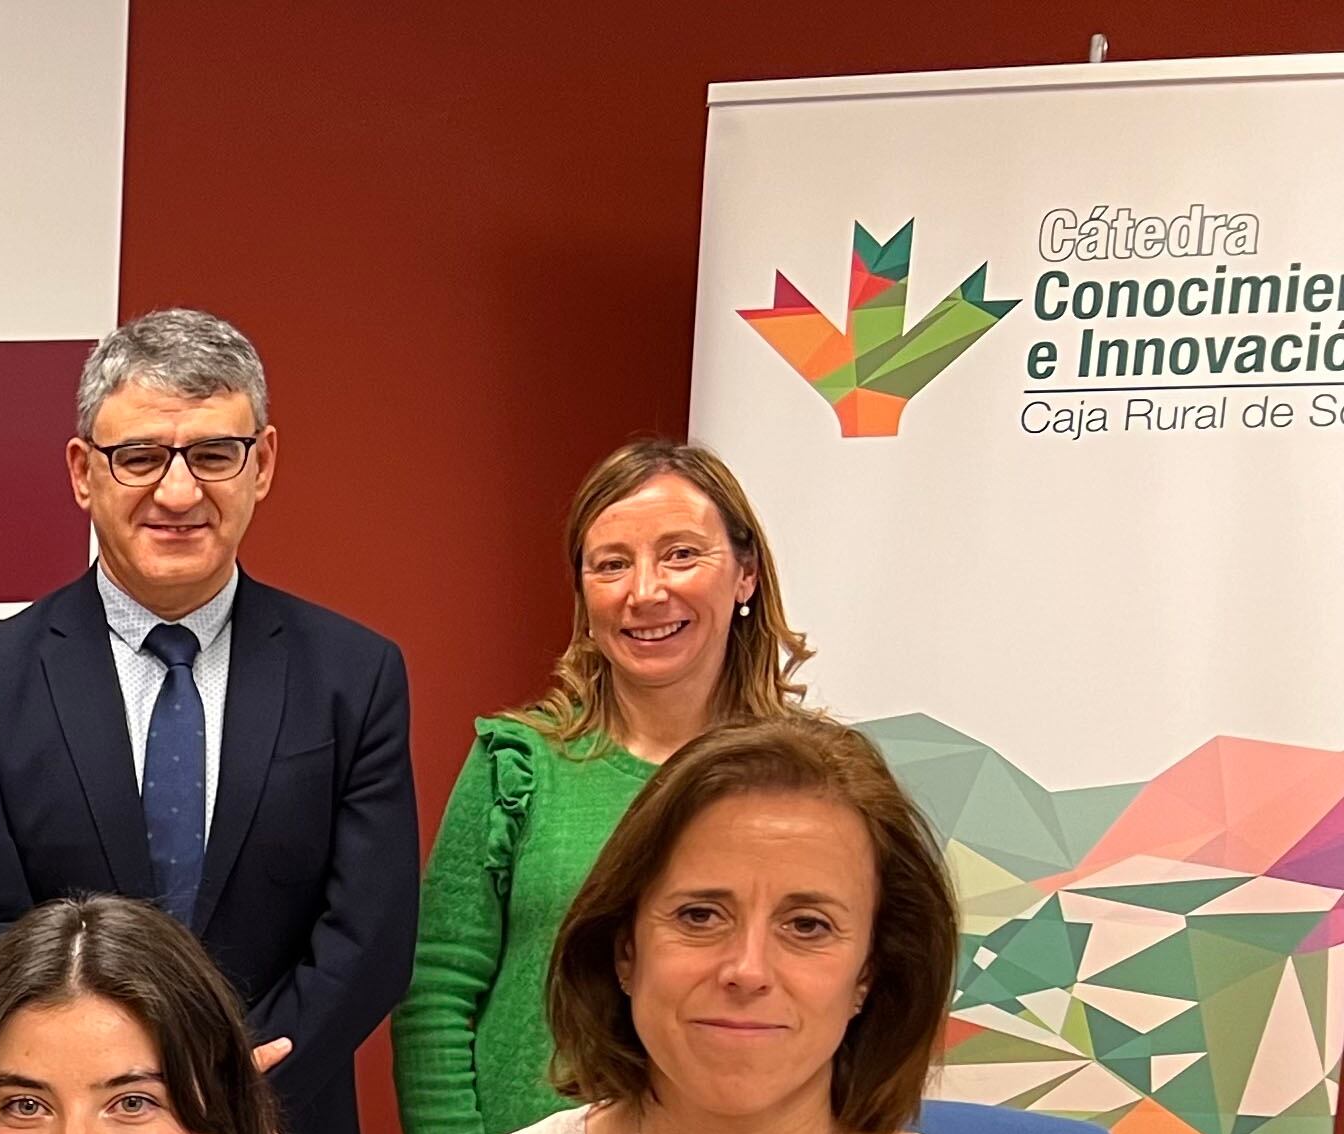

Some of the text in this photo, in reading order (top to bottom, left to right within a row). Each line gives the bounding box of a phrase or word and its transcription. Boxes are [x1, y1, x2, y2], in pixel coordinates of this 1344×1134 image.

[1038, 203, 1260, 263] Cátedra
[1033, 262, 1344, 321] Conocimie
[1026, 340, 1058, 380] e
[1020, 400, 1109, 440] Caja
[1124, 396, 1227, 431] Rural
[1241, 395, 1295, 429] de
